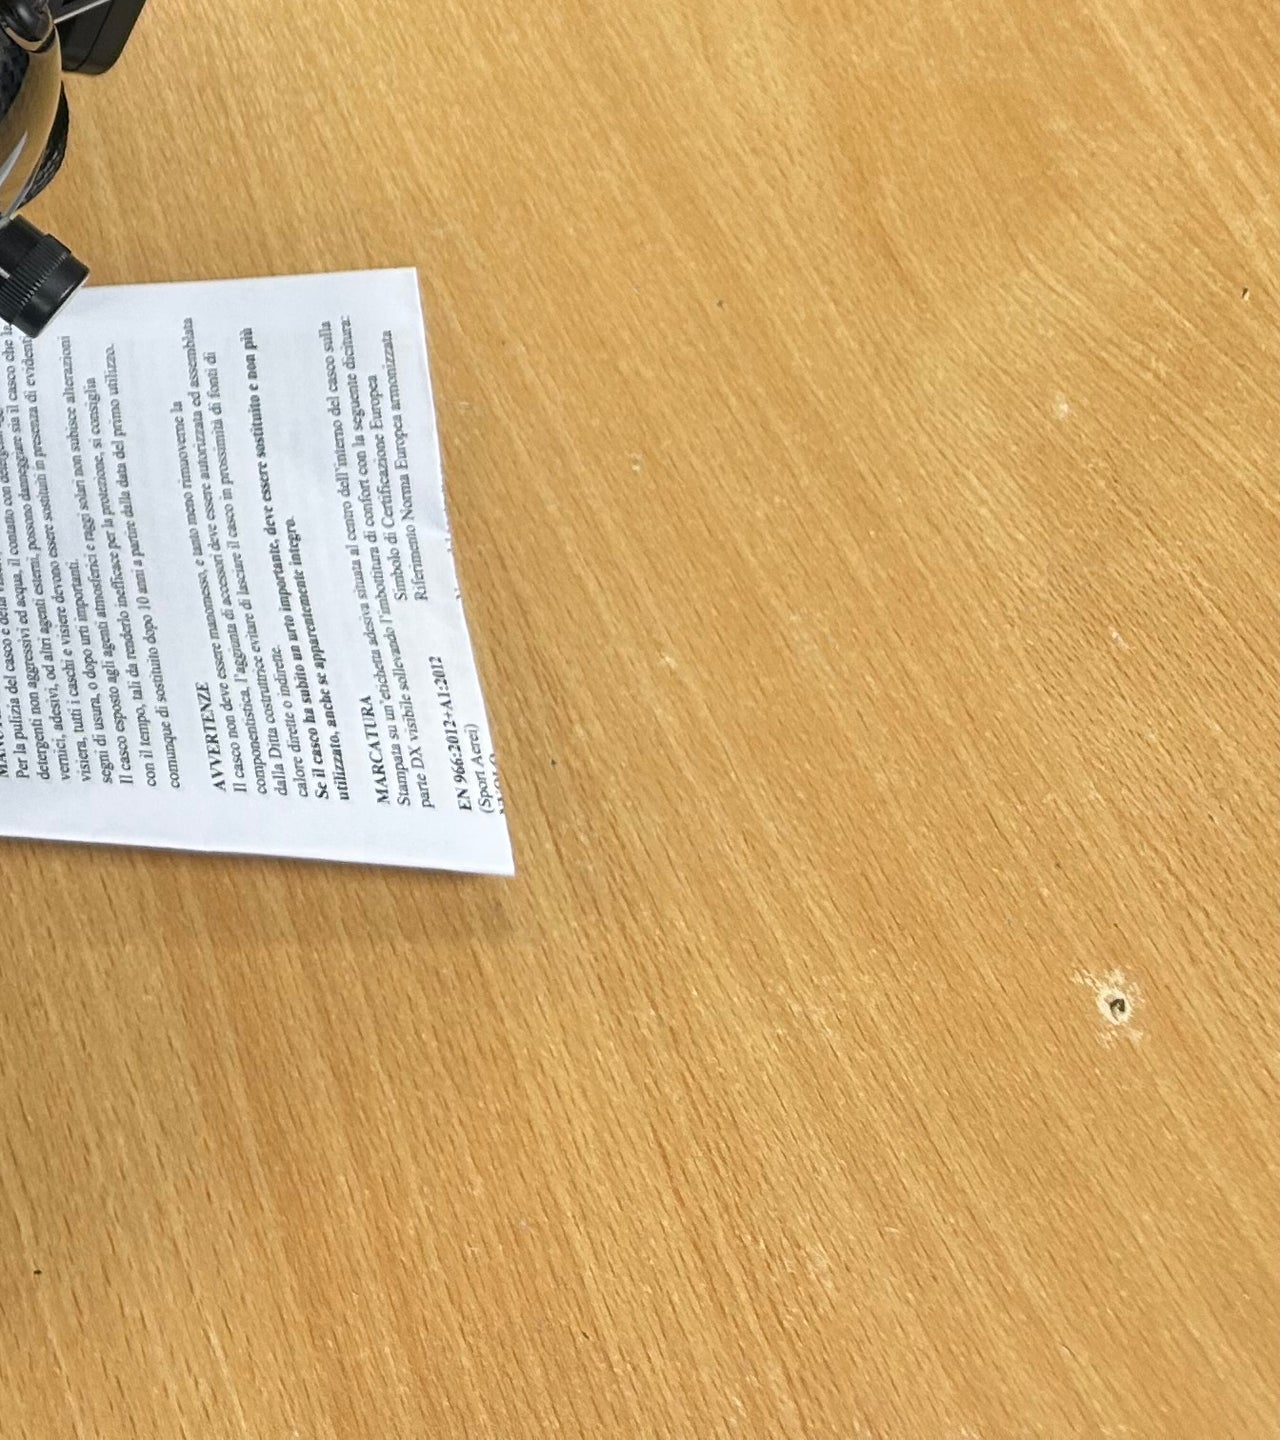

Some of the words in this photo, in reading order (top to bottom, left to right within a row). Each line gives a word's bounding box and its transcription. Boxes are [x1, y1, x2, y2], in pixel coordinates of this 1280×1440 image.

[238, 328, 255, 351] più
[318, 321, 333, 353] sulla
[339, 317, 355, 371] dicitura:
[244, 354, 256, 381] non
[324, 355, 338, 393] casco
[382, 330, 401, 411] armonizzata
[327, 396, 342, 417] del
[345, 373, 365, 432] seguente
[368, 375, 383, 431] Europea
[248, 394, 267, 459] sostituito
[353, 434, 366, 447] la
[392, 414, 408, 470] Europea
[333, 419, 354, 498] dell'interno
[357, 450, 370, 477] con
[258, 461, 274, 503] essere
[374, 434, 396, 529] Certificazione
[399, 473, 415, 521] Norma
[265, 506, 280, 536] deve
[345, 501, 361, 541] centro
[360, 479, 379, 527] confort
[284, 516, 303, 567] integro.
[349, 544, 363, 556] al
[367, 530, 381, 543] di
[385, 532, 399, 545] di
[270, 538, 293, 613] importante,
[354, 559, 371, 600] situata
[388, 547, 408, 601] Simbolo
[405, 524, 428, 601] Riferimento
[67, 558, 88, 623] importanti.
[372, 546, 396, 624] l'imbottitura
[77, 625, 91, 646] urti
[283, 614, 299, 642] urto
[294, 570, 326, 670] apparentemente
[362, 602, 380, 647] adesiva
[82, 648, 97, 680] dopo
[271, 644, 291, 697] indirette.
[290, 644, 303, 662] un
[385, 627, 409, 691] sollevando
[293, 664, 311, 705] subito
[316, 672, 328, 686] se
[370, 649, 395, 722] un'etichetta
[89, 692, 104, 731] usura,
[301, 707, 315, 724] ha
[317, 688, 336, 728] anche
[398, 694, 419, 742] visibile
[429, 656, 468, 784] 966:2012+A1:2012
[93, 734, 107, 747] di
[197, 683, 227, 791] AVVERTENZE
[284, 712, 301, 753] dirette
[306, 727, 324, 766] casco
[359, 696, 391, 804] MARCATURA
[386, 724, 399, 740] su
[464, 723, 484, 767] Aerei)
[96, 750, 114, 784] segni
[292, 756, 308, 798] calore
[312, 768, 327, 779] il
[328, 730, 351, 801] utilizzato,
[389, 743, 413, 807] Stampata
[407, 747, 425, 770] DX
[317, 782, 332, 800] Se
[415, 773, 437, 809] parte
[455, 788, 472, 811] EN
[473, 770, 498, 814] (Sport
